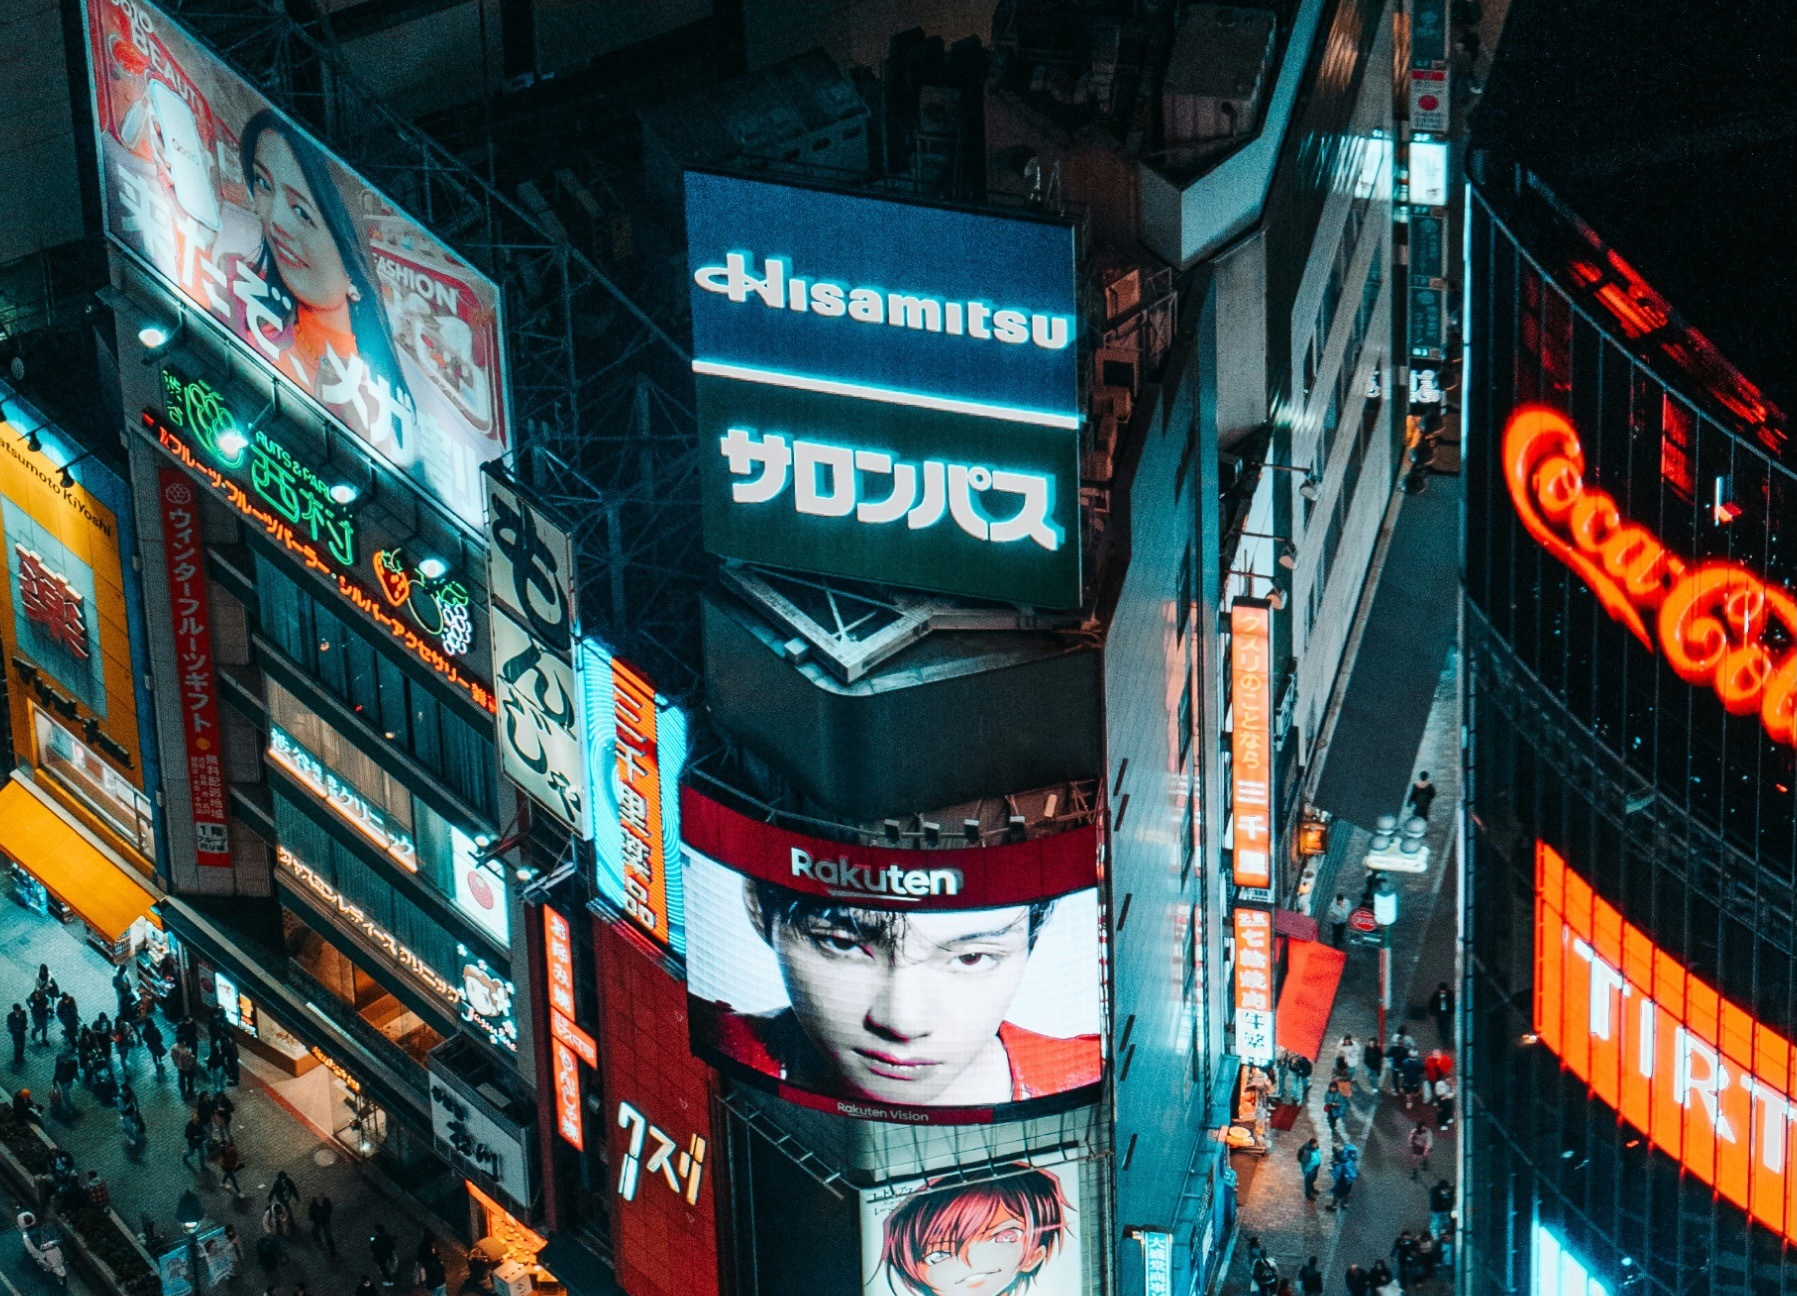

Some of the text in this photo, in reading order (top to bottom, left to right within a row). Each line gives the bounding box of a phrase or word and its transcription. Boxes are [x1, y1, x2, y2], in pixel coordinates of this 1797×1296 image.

[694, 252, 1069, 350] Hisamitsu
[719, 427, 1060, 552] サロンパス
[168, 508, 212, 734] ウィンターフルーツギフト
[1238, 614, 1263, 770] クスリのことなら
[790, 846, 964, 898] Rakuten
[618, 1100, 707, 1207] クスリ
[837, 1100, 930, 1124] Rakuten Vision
